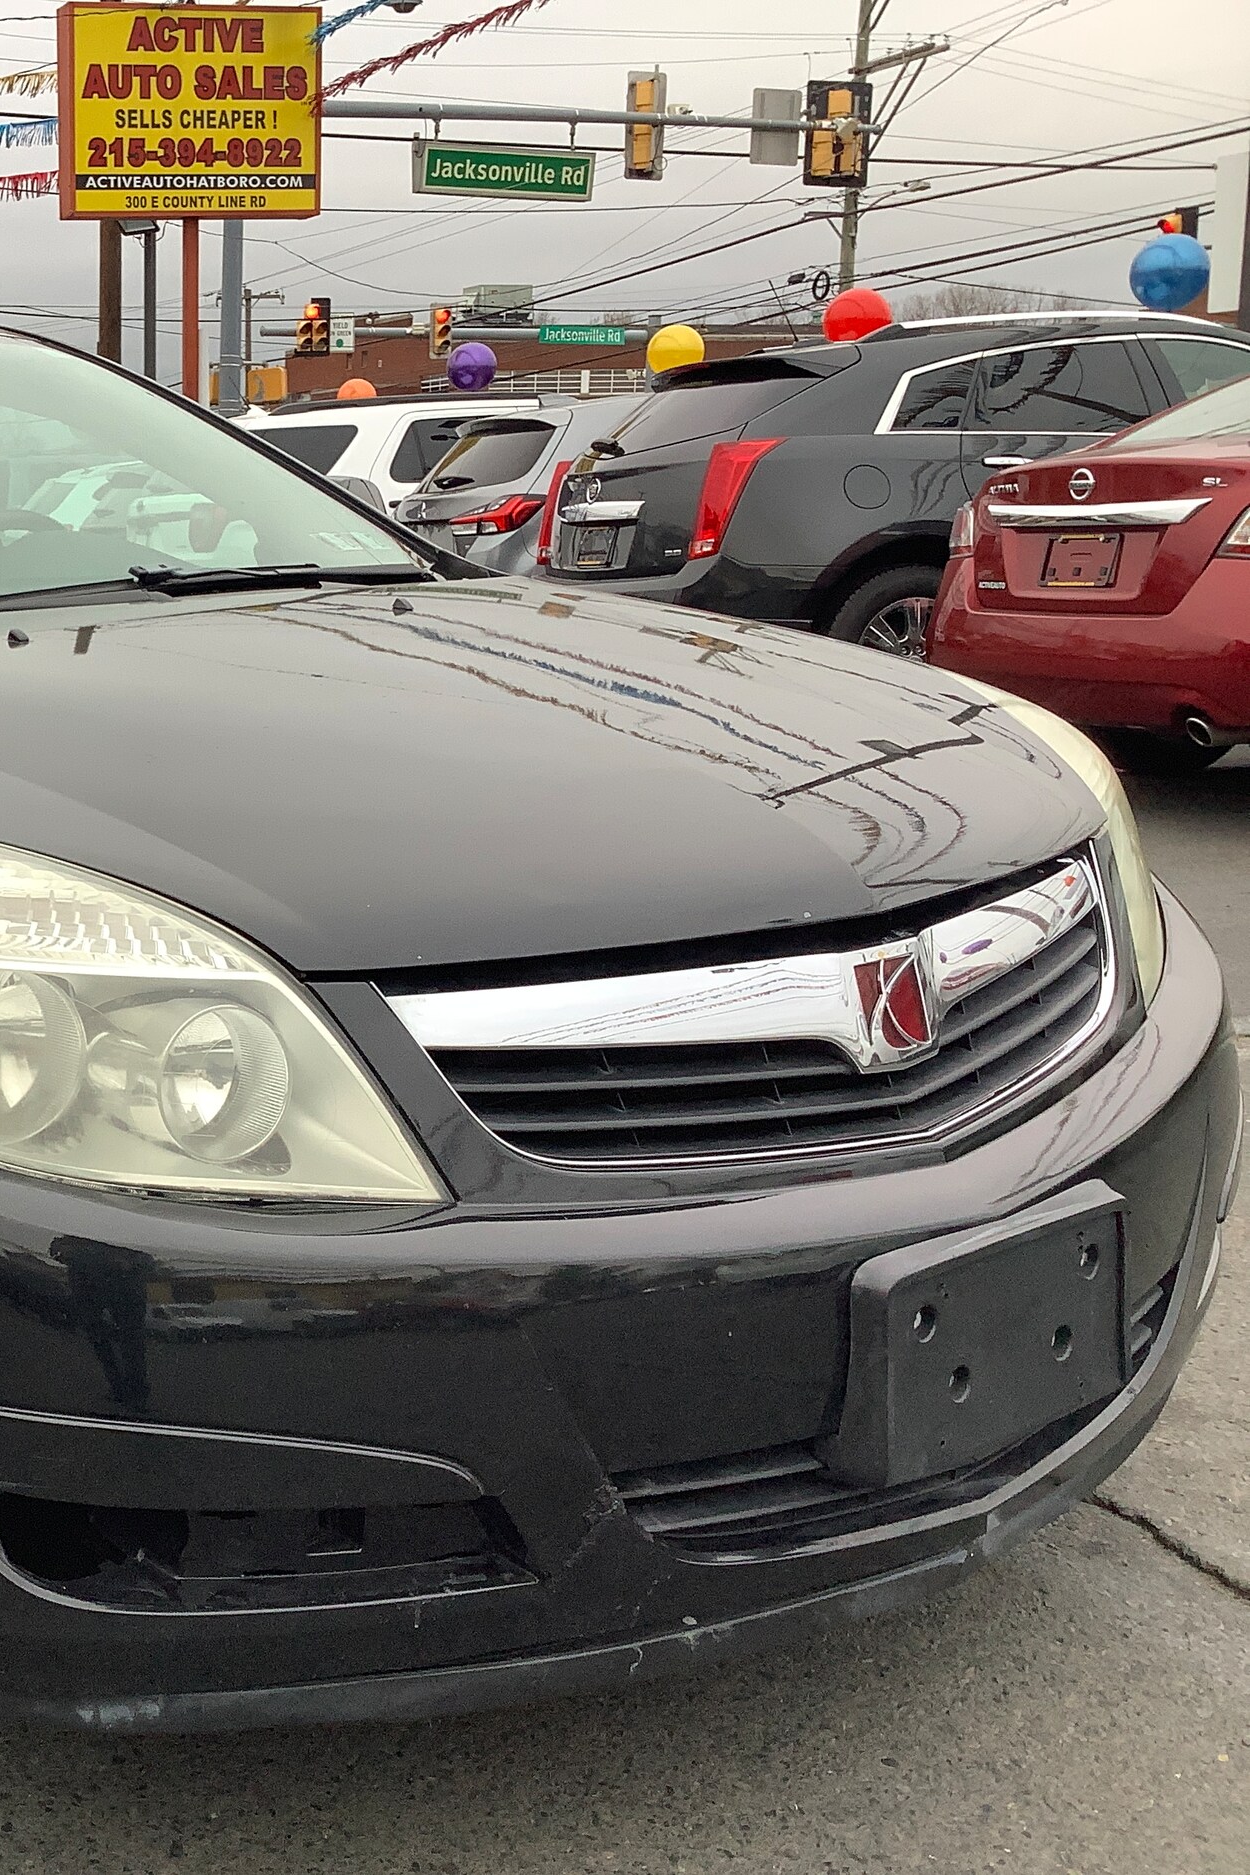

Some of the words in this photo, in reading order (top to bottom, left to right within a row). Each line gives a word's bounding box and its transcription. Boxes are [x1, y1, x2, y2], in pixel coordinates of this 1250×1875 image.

[126, 16, 264, 53] ACTIVE
[82, 63, 182, 99] AUTO
[194, 65, 308, 101] SALES
[115, 109, 173, 129] SELLS
[180, 110, 266, 129] CHEAPER
[88, 137, 302, 168] 215-394-8922
[431, 158, 555, 185] Jacksonville
[561, 166, 585, 186] Rd
[85, 175, 303, 188] ACTIVEAUTOHATBORO.COM
[125, 196, 147, 208] 300
[151, 197, 158, 208] E
[162, 195, 214, 208] COUNTY
[218, 195, 247, 208] LINE
[251, 196, 266, 208] RD
[332, 322, 349, 330] YIELD
[544, 326, 606, 342] Jacksonville
[607, 329, 621, 342] Rd
[1202, 476, 1229, 487] SL
